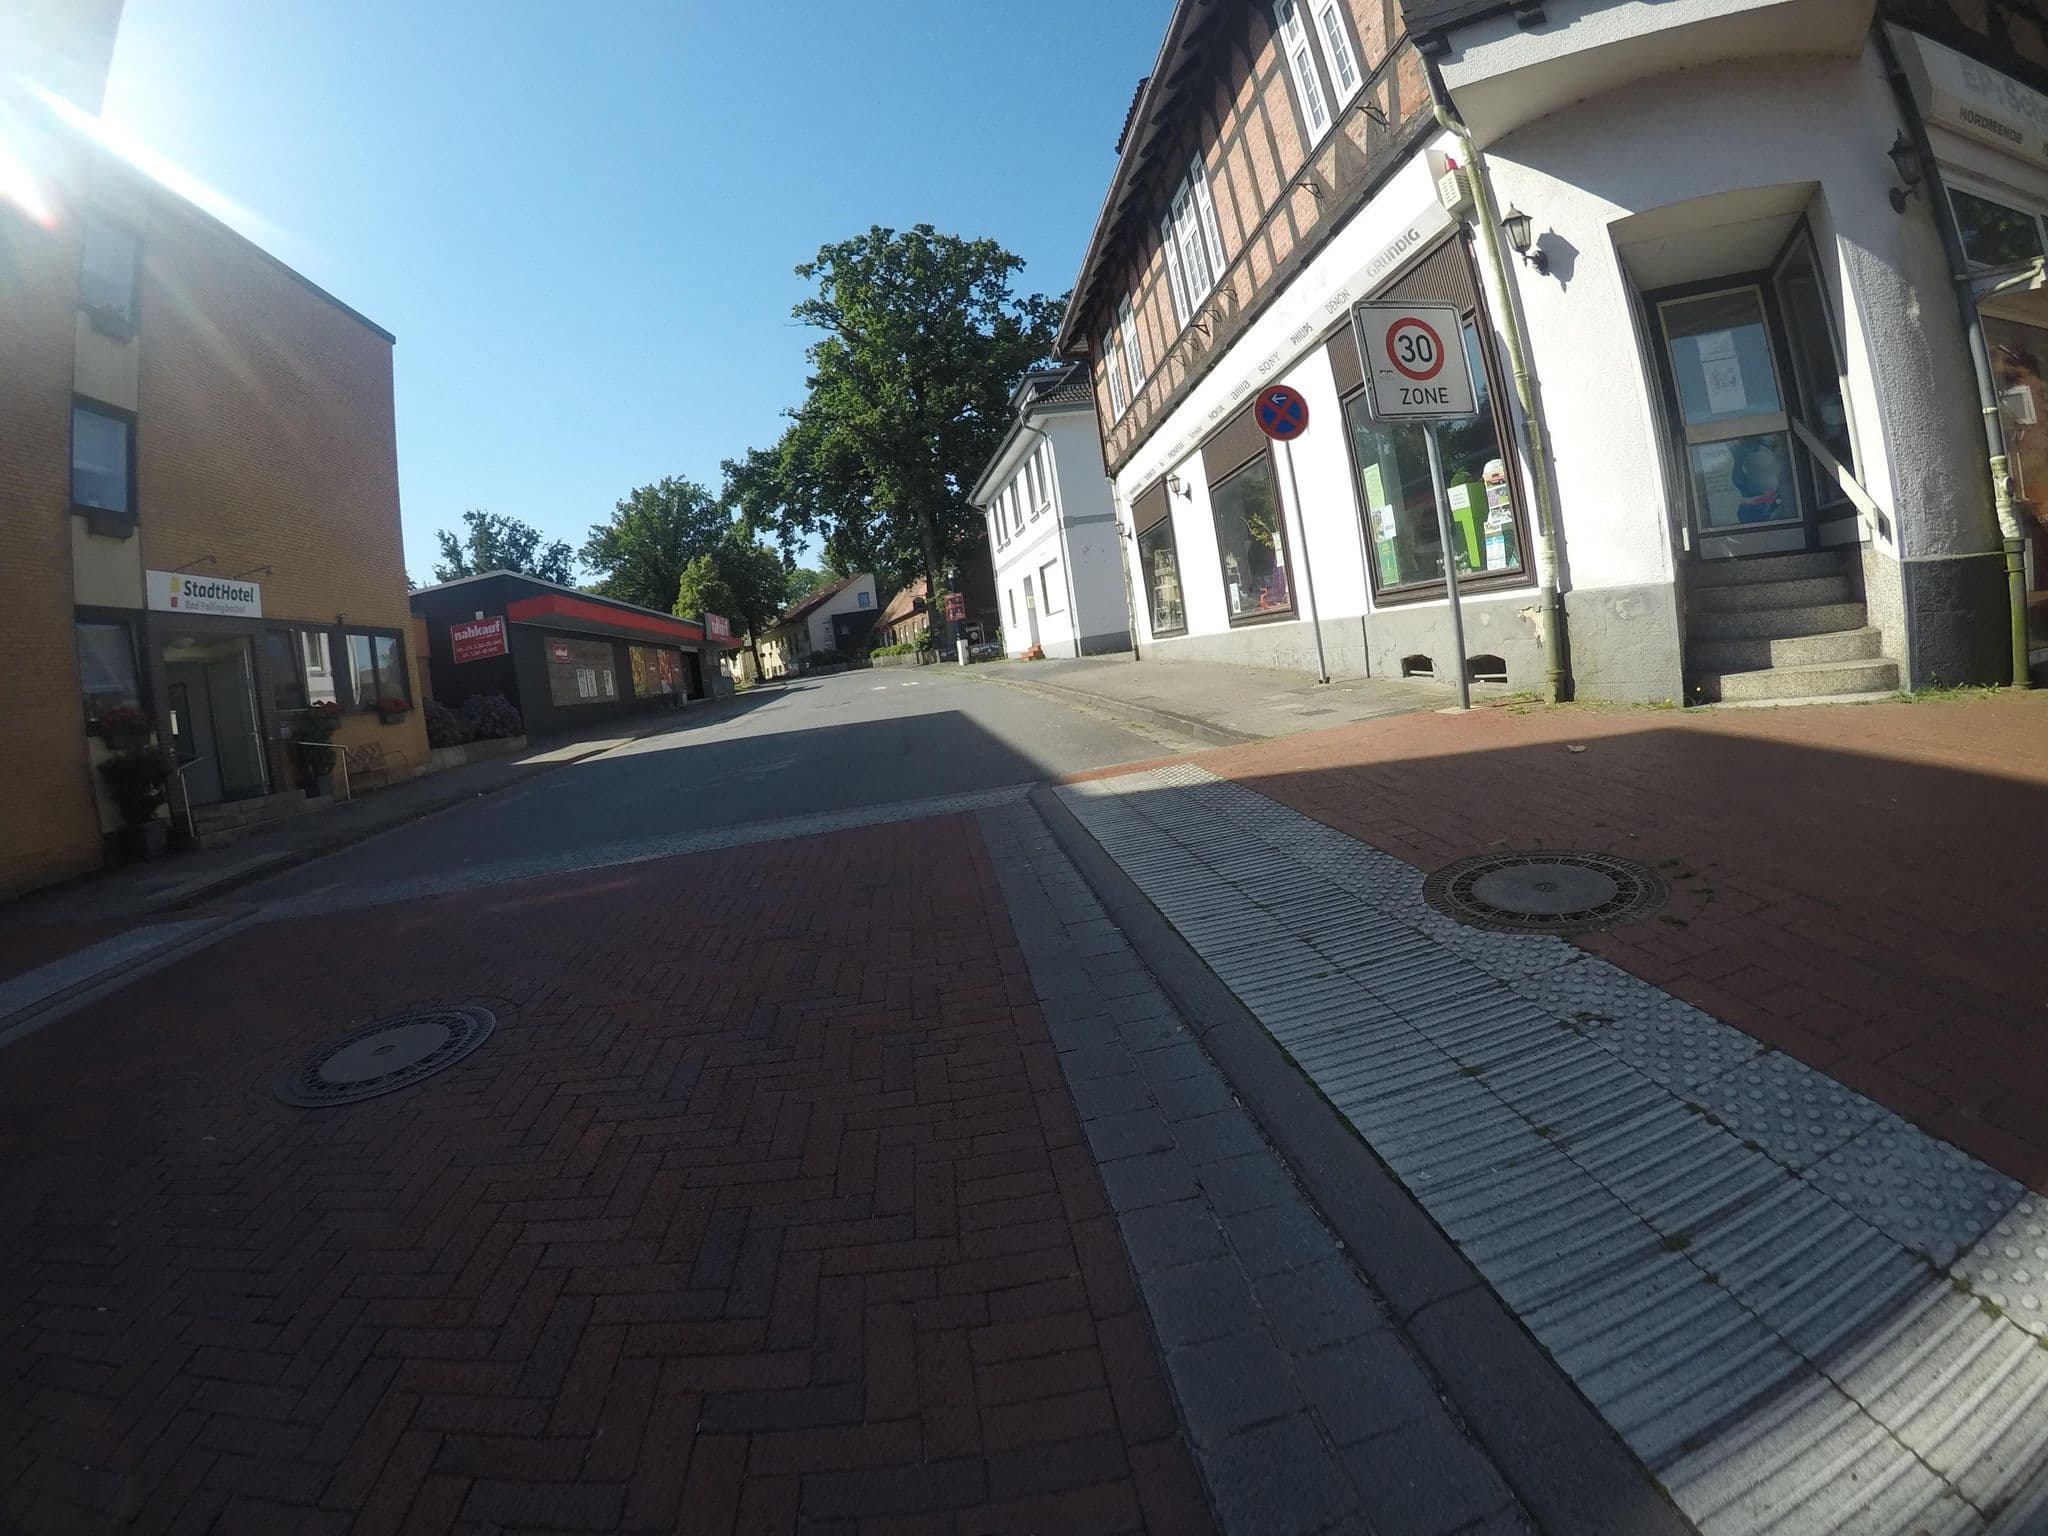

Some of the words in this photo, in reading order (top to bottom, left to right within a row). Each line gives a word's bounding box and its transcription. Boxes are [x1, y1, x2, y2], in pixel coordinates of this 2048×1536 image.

[1258, 351, 1281, 375] SONY
[1290, 322, 1314, 345] PHILIPS
[1324, 288, 1352, 315] DENON
[1366, 228, 1421, 278] GRUNDIG
[1398, 334, 1433, 363] 30
[1400, 387, 1450, 405] ZONE
[183, 580, 254, 603] StadtHotel
[454, 620, 501, 641] nahkauf
